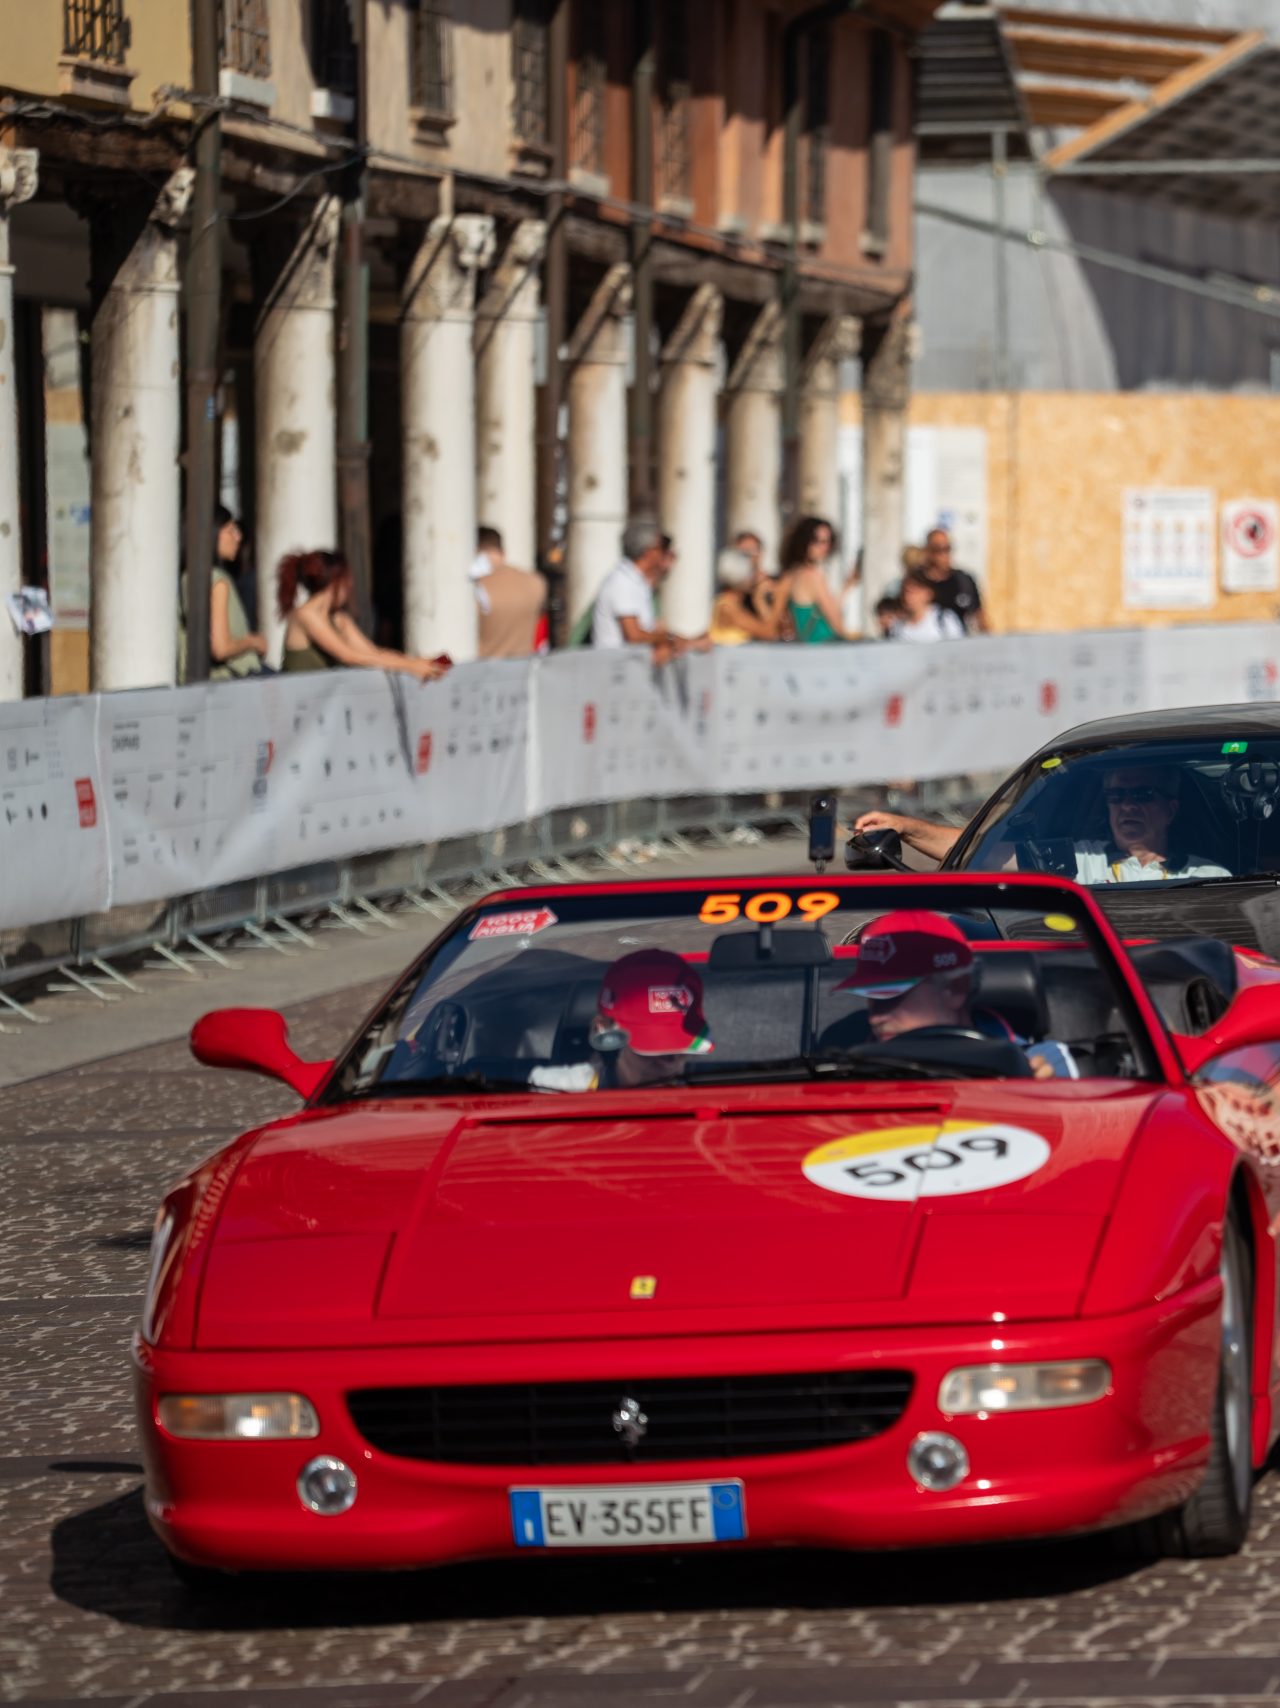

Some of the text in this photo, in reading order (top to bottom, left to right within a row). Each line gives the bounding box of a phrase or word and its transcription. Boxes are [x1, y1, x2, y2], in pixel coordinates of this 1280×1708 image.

[698, 891, 840, 924] 509
[844, 1136, 1009, 1187] 509
[546, 1496, 708, 1537] EV 355FF
